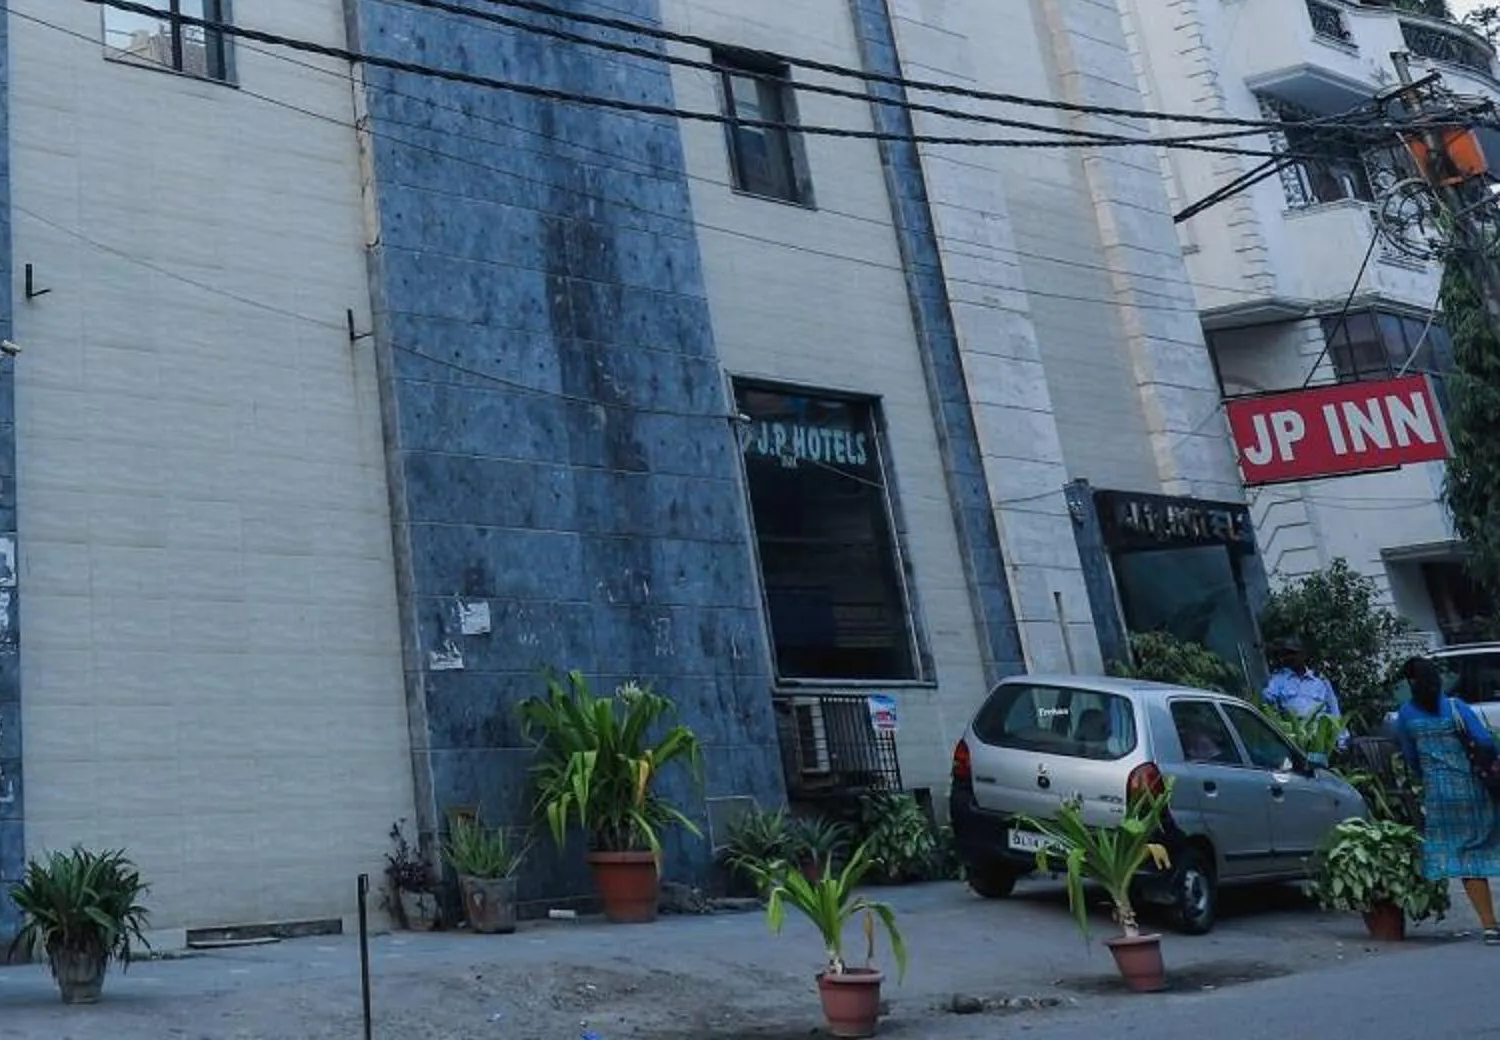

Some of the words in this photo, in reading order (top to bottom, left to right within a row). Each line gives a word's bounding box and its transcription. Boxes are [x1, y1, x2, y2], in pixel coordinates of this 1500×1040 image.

[792, 424, 867, 464] HOTELS
[1243, 410, 1306, 465] JP
[1322, 391, 1437, 455] INN
